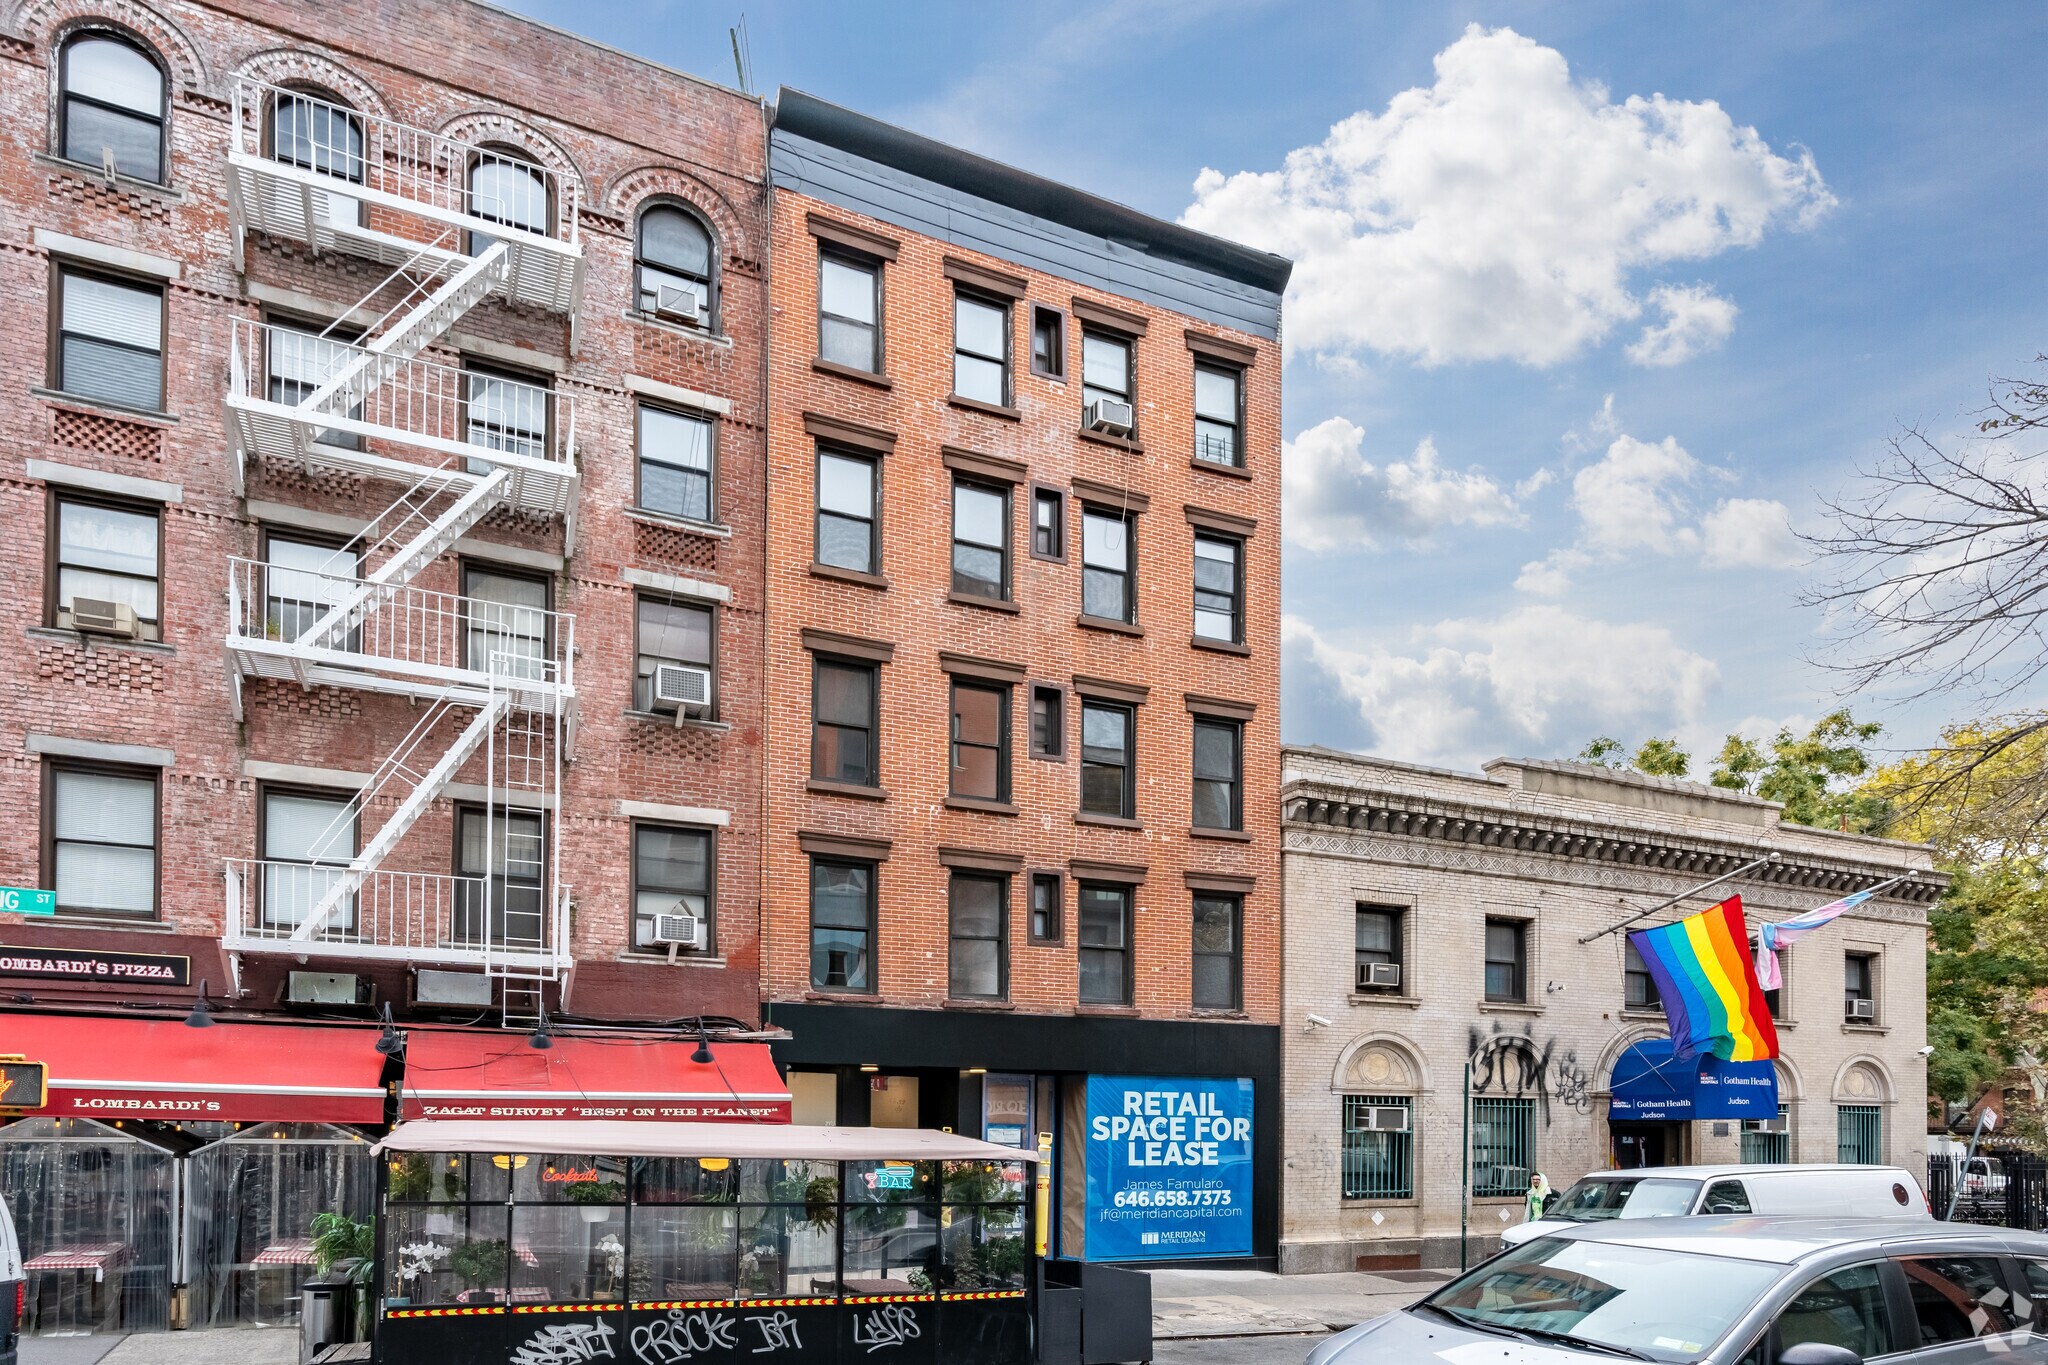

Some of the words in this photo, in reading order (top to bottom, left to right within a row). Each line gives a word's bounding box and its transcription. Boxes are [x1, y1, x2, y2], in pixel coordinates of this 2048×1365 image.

[36, 893, 51, 904] ST
[112, 963, 175, 979] PIZZA
[1723, 1076, 1750, 1085] Gotham
[1750, 1077, 1772, 1087] Health
[73, 1098, 221, 1111] LOMBARDI'S
[1123, 1091, 1224, 1117] RETAIL
[1636, 1100, 1666, 1108] Gotham
[1666, 1100, 1691, 1108] Health
[1727, 1096, 1750, 1105] Judson
[423, 1106, 486, 1116] ZAGAT
[490, 1107, 567, 1116] SURVEY
[632, 1108, 656, 1117] ON
[660, 1108, 698, 1116] THE
[1641, 1111, 1666, 1119] Judson
[1091, 1116, 1187, 1142] SPACE
[1195, 1117, 1251, 1141] FOR
[1128, 1142, 1220, 1167] LEASE
[542, 1167, 598, 1182] Cocktails
[879, 1175, 913, 1190] BAR
[1122, 1179, 1163, 1190] James
[1167, 1178, 1224, 1190] Famularo
[1114, 1189, 1232, 1208] 646.658.7373
[1099, 1207, 1243, 1223] jf@meridiancapital.com
[1161, 1230, 1206, 1239] MERIDIAN
